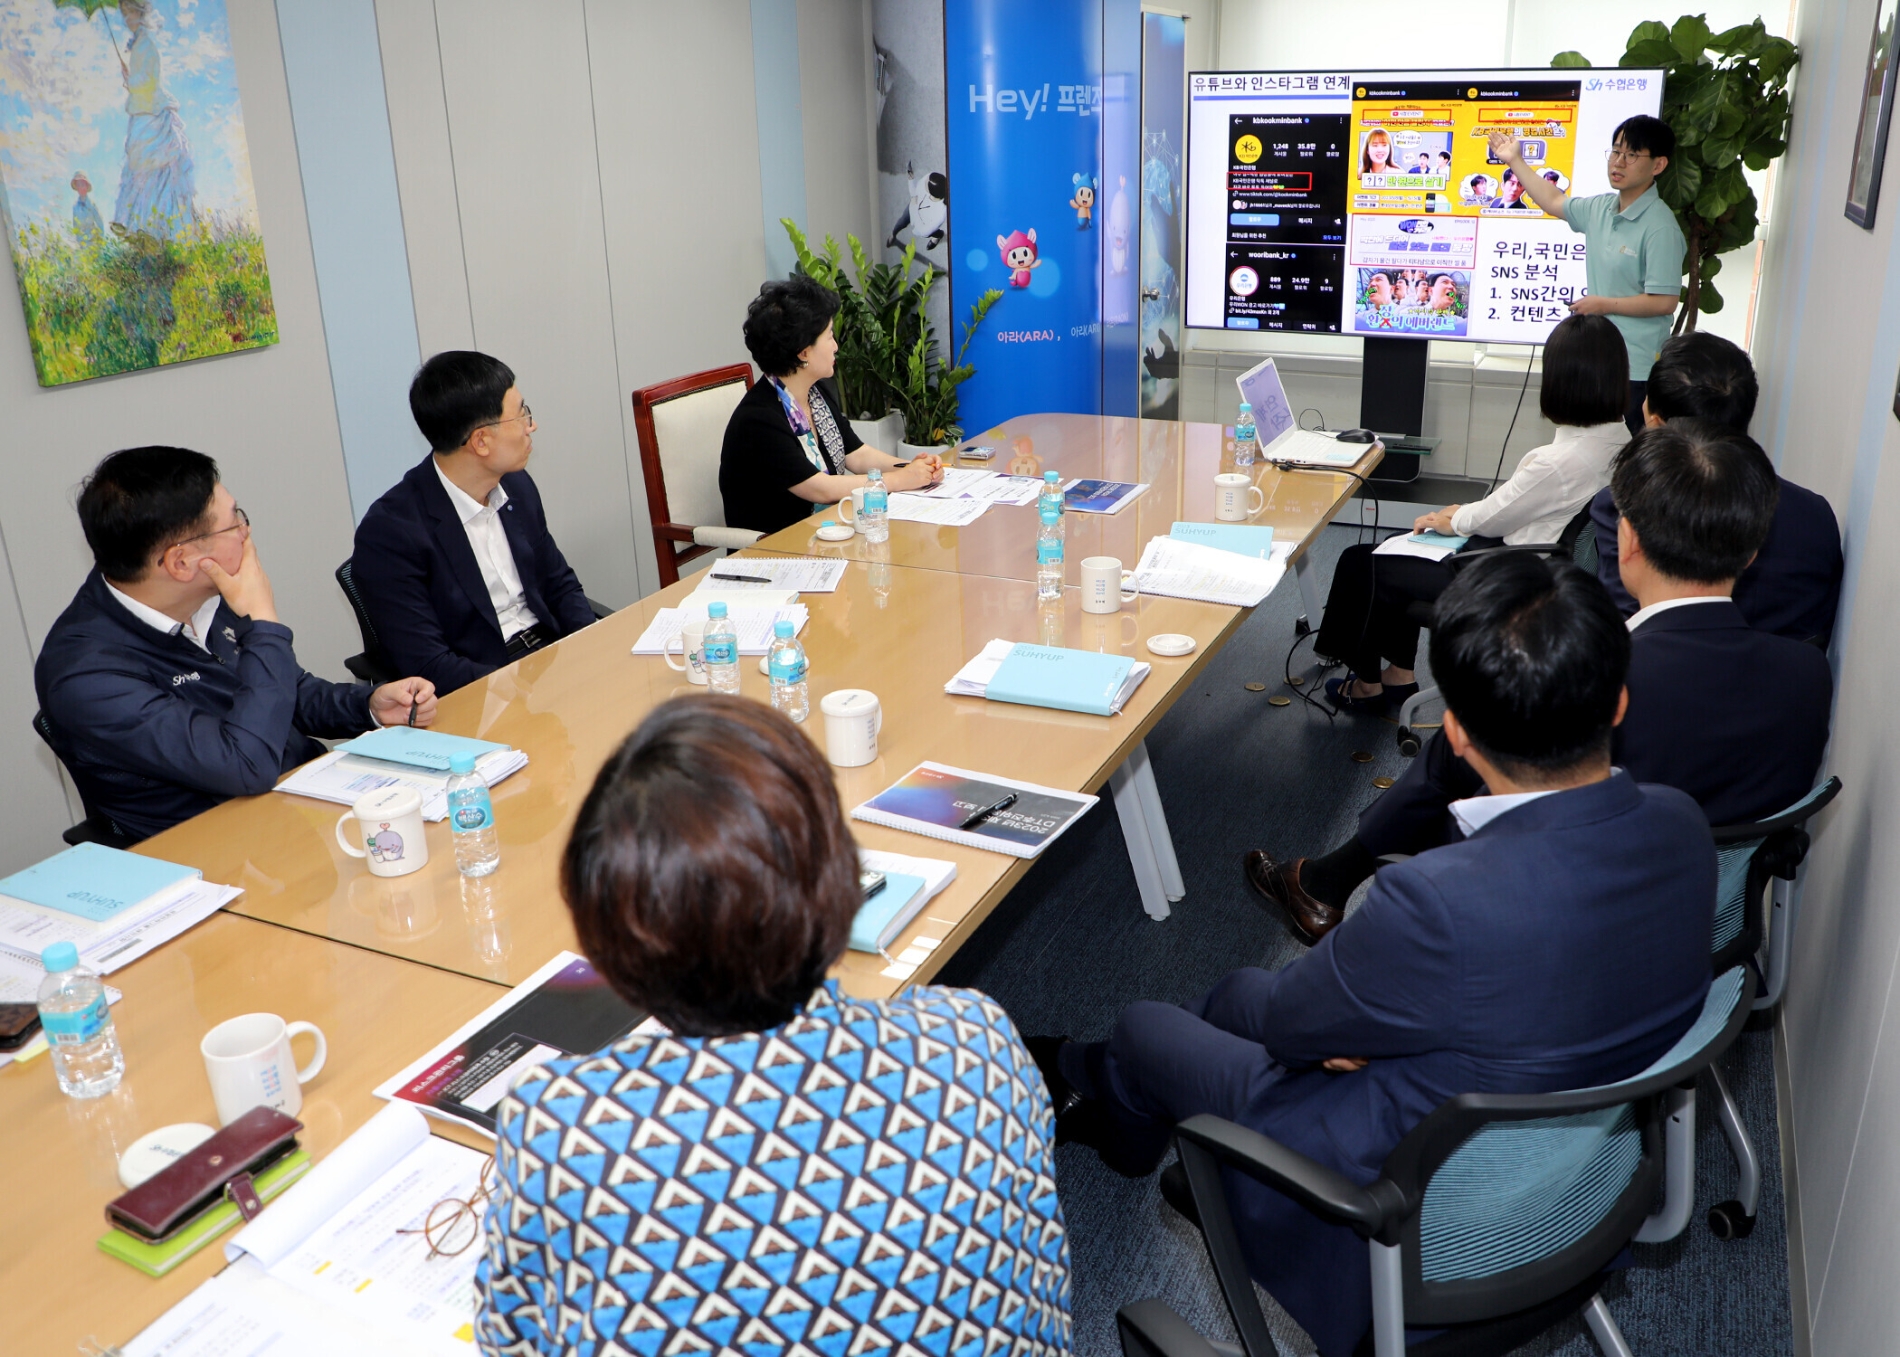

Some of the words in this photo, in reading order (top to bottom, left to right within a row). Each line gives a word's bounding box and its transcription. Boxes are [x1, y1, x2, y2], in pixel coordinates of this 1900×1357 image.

[1194, 77, 1247, 92] 유튜브와
[1251, 76, 1319, 91] 인스타그램
[1323, 75, 1350, 90] 연계
[1585, 78, 1603, 91] Sh
[1605, 78, 1647, 91] 수협은행
[969, 83, 1050, 120] Hey!
[1253, 116, 1302, 124] kbkookminbank
[1248, 251, 1289, 259] wooribank_kr
[1491, 266, 1519, 279] SNS
[1524, 264, 1558, 281] 분석
[1490, 287, 1502, 299] 1.
[1510, 286, 1574, 303] SNS간의
[1488, 308, 1500, 320] 2.
[1510, 306, 1561, 323] 컨텐츠
[1405, 315, 1455, 330] 에버랜드
[1174, 527, 1217, 536] SUHYUP
[1013, 649, 1064, 661] SUHYUP
[1002, 820, 1049, 834] 2023년
[66, 890, 125, 910] SUHYUP
